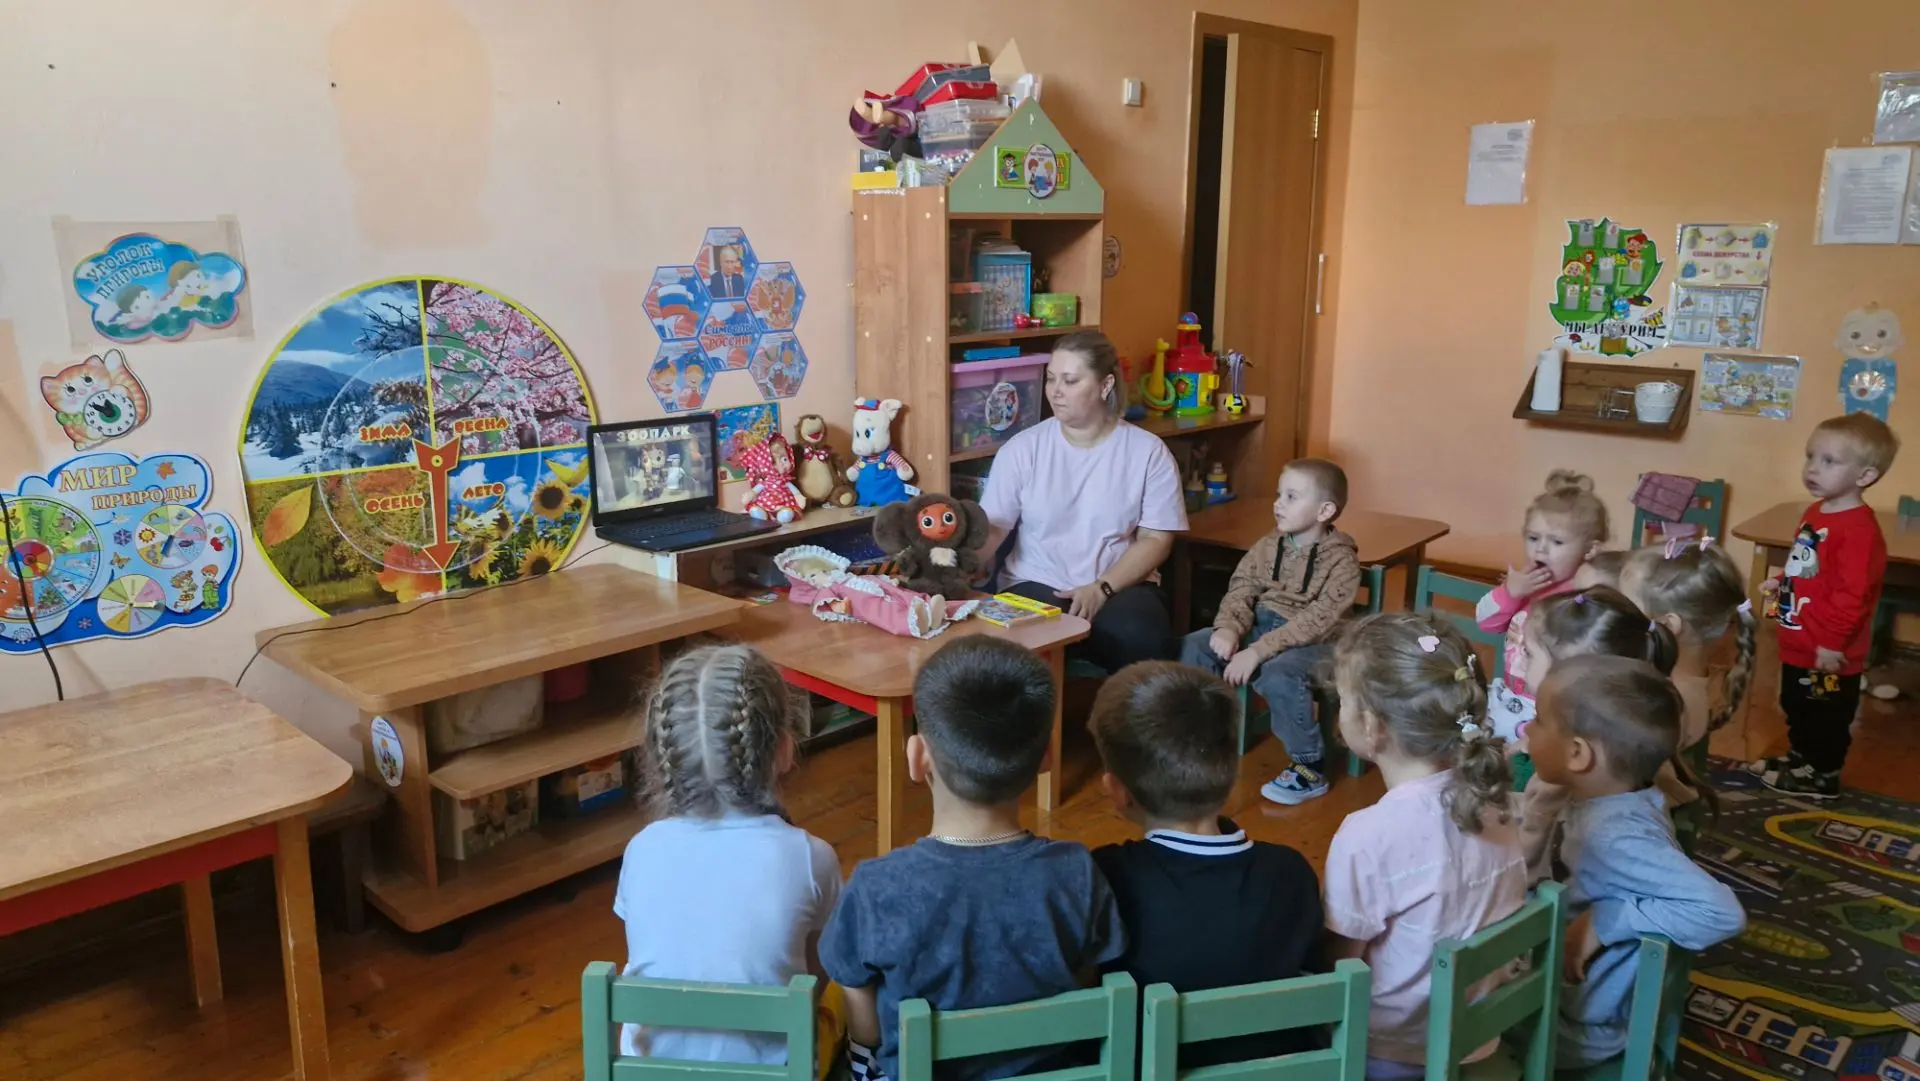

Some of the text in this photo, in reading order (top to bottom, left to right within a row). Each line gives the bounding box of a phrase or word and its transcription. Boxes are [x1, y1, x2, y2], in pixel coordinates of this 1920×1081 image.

[86, 243, 152, 282] УГОЛОК
[96, 258, 165, 300] ПРИРОДЫ
[1565, 322, 1657, 338] МЫ ДУРИМ
[359, 423, 412, 442] ЗИМА
[616, 425, 691, 442] ЗООПАРК
[59, 464, 137, 492] МИР
[92, 485, 196, 510] ПРИРОДЫ
[462, 482, 505, 500] ЛЕТО
[364, 493, 425, 514] ОСЕНЬ
